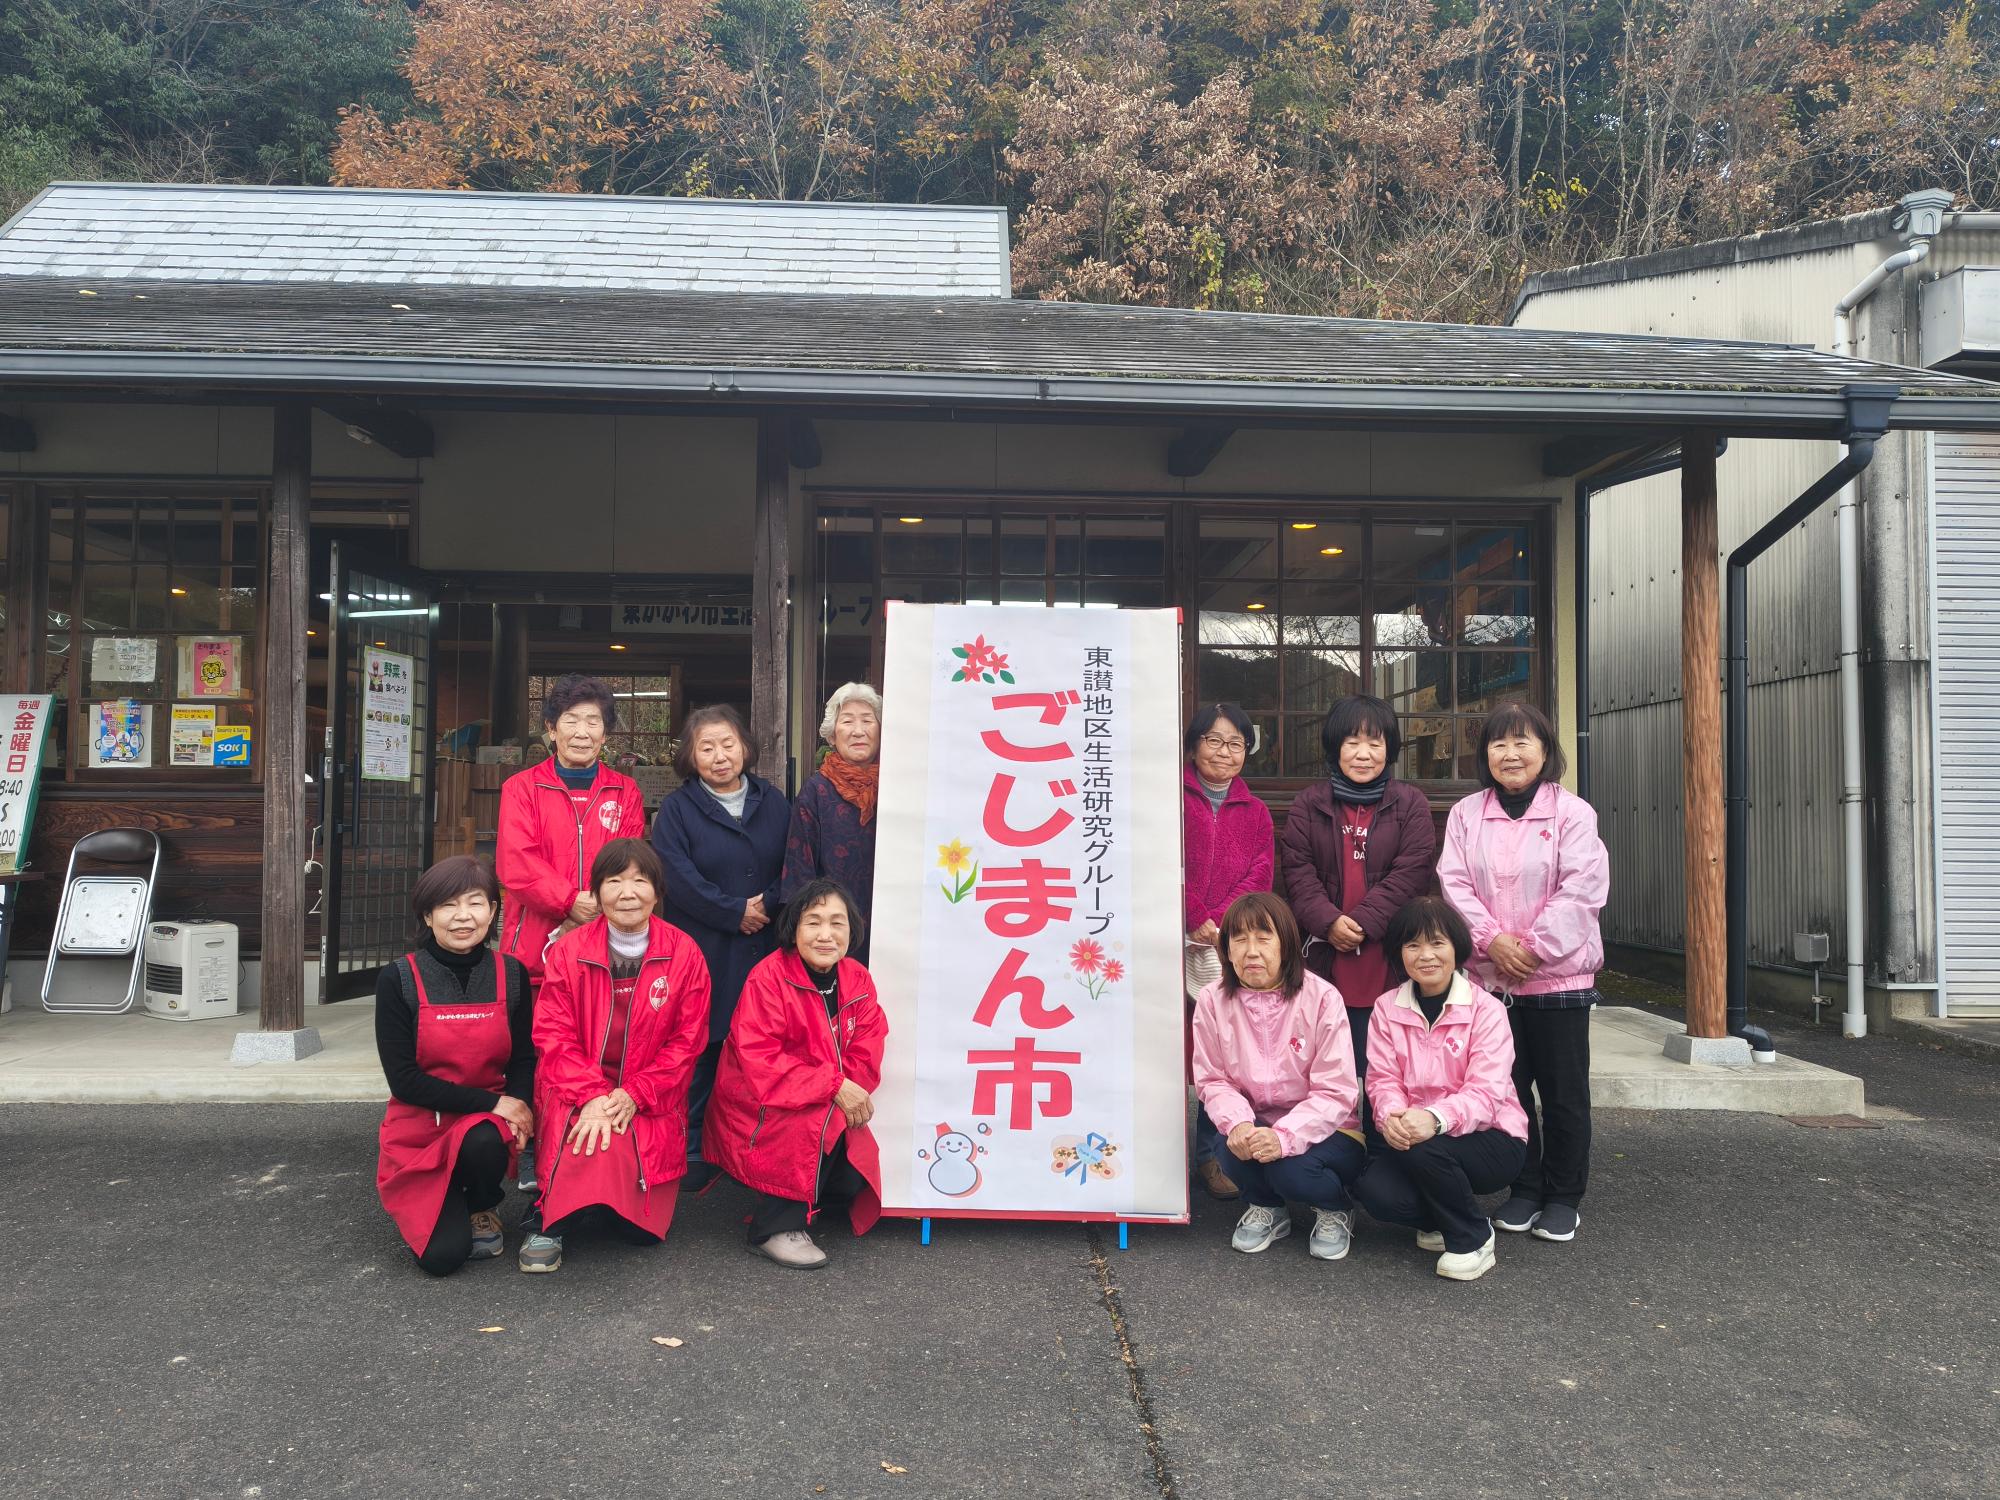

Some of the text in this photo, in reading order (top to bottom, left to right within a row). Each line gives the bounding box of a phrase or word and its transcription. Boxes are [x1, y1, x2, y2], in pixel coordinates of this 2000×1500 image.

[6, 711, 36, 773] 金曜日
[17, 700, 40, 710] 毎週
[1082, 646, 1114, 935] 東讃地区生活研究グループ
[967, 689, 1081, 1130] ごじまん市
